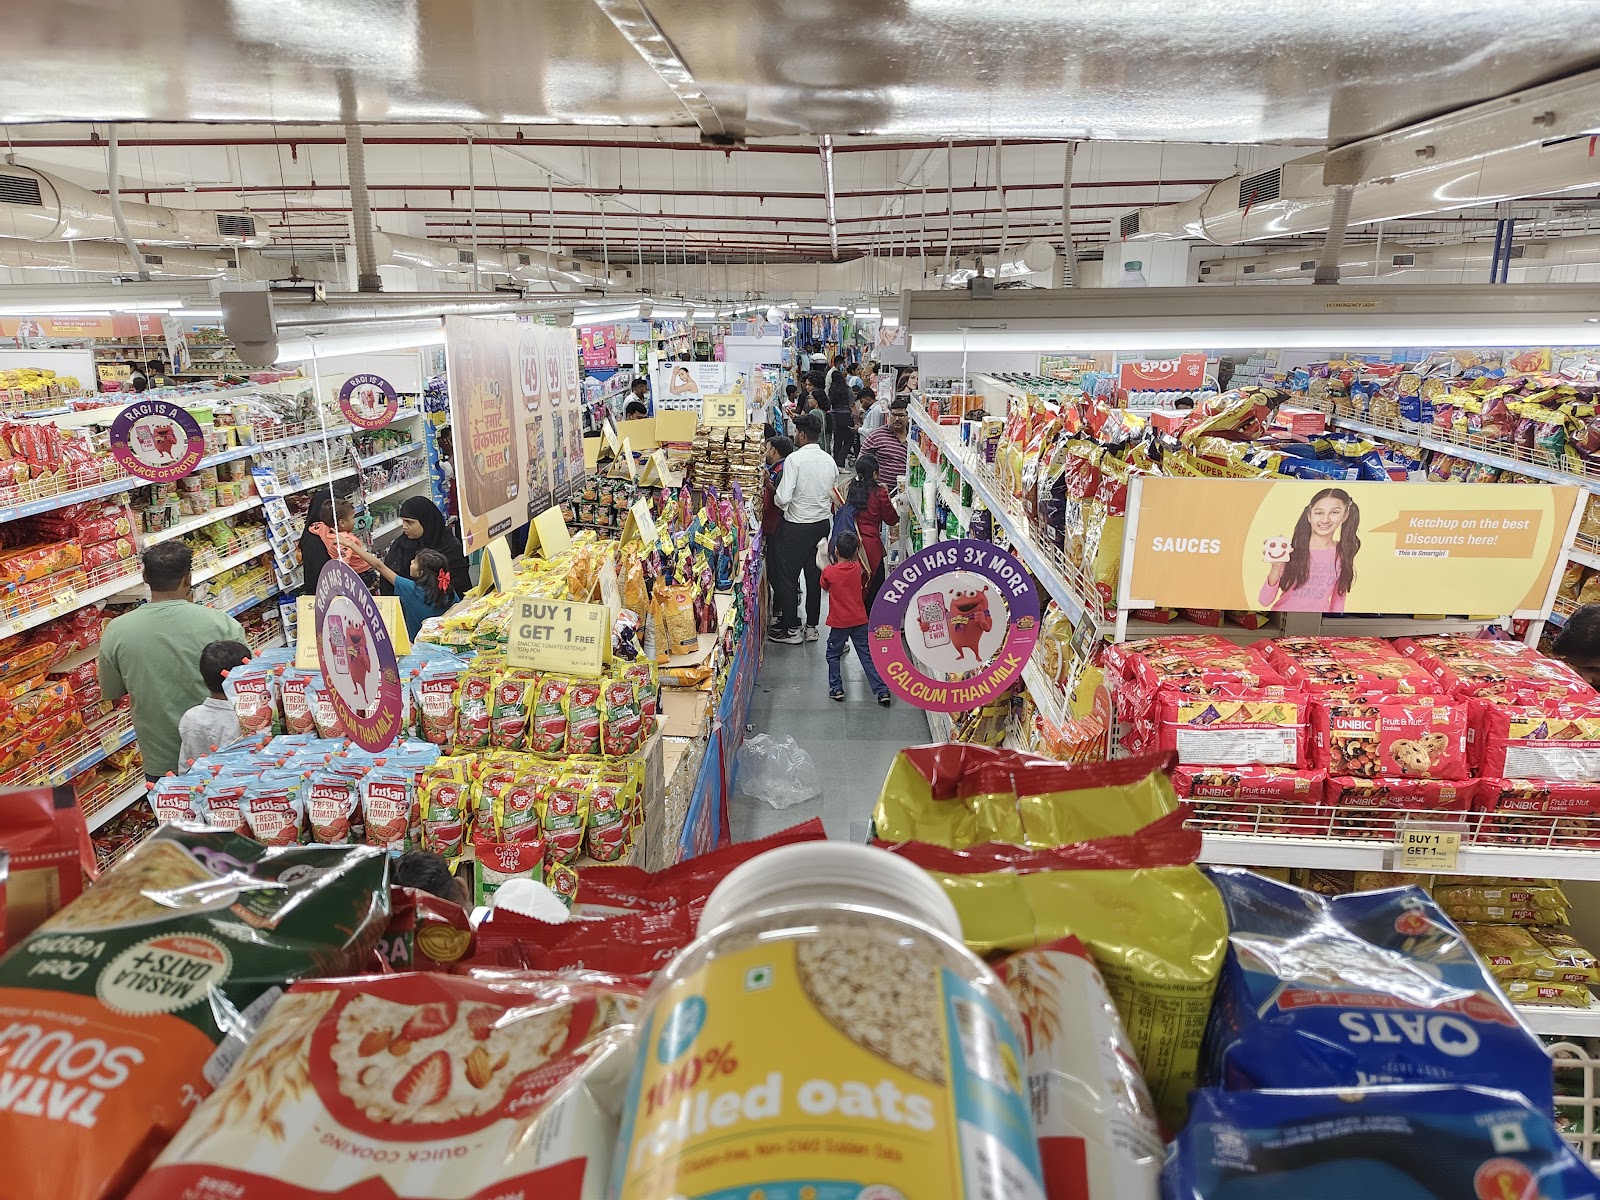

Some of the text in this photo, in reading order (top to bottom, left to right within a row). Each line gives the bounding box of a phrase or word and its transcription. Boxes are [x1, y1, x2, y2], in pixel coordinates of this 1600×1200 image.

[1140, 360, 1180, 372] SPOT
[350, 376, 367, 387] RAGI
[124, 404, 178, 421] RAGI IS A
[122, 456, 156, 478] SOURCE
[170, 452, 200, 476] PROTEIN
[1168, 460, 1187, 476] SUPER
[1196, 462, 1222, 478] SUPER
[1409, 517, 1530, 530] Ketchup on the best
[1152, 536, 1221, 554] SAUCES
[1405, 533, 1498, 545] Discounts here!
[882, 547, 1029, 605] RAGI HAS 3X MORE
[318, 569, 385, 642] RAGI HAS 3X MORE
[522, 604, 572, 622] BUY 1
[520, 624, 595, 644] GET 1 FREE
[928, 624, 944, 633] SCAN
[934, 630, 945, 640] WIN
[886, 653, 1022, 705] CALCIUM THAN MILK
[326, 674, 395, 744] CALCIUM THAN MILK
[1336, 720, 1372, 730] UNIBIC
[314, 787, 348, 800] kissan
[372, 785, 405, 800] kissan
[1197, 788, 1232, 797] UNIBIC
[159, 796, 189, 809] kissan
[253, 800, 289, 812] kissan
[313, 801, 334, 809] FRESH
[370, 801, 391, 809] FRESH
[1504, 801, 1540, 811] UNIBIC
[255, 813, 277, 822] FRESH
[312, 810, 338, 818] TOMATO
[369, 809, 395, 818] TOMATO
[255, 822, 283, 832] TOMATO
[1409, 835, 1440, 844] BUY 1
[494, 846, 520, 860] Good
[1407, 847, 1428, 855] GET
[1431, 847, 1436, 856] 1
[500, 856, 520, 870] Life
[27, 935, 106, 960] Veggie
[27, 959, 89, 981] Desi
[133, 950, 213, 982] OATS+
[112, 969, 196, 999] MASALA
[1139, 982, 1171, 990] SERVINGS
[1139, 1007, 1152, 1017] 428
[1140, 1018, 1149, 1029] 9.1
[1339, 1012, 1481, 1058] OATS
[646, 1042, 739, 1118] 100%
[632, 1072, 935, 1172] rolled oats
[320, 1132, 468, 1163] QUICK COOKING
